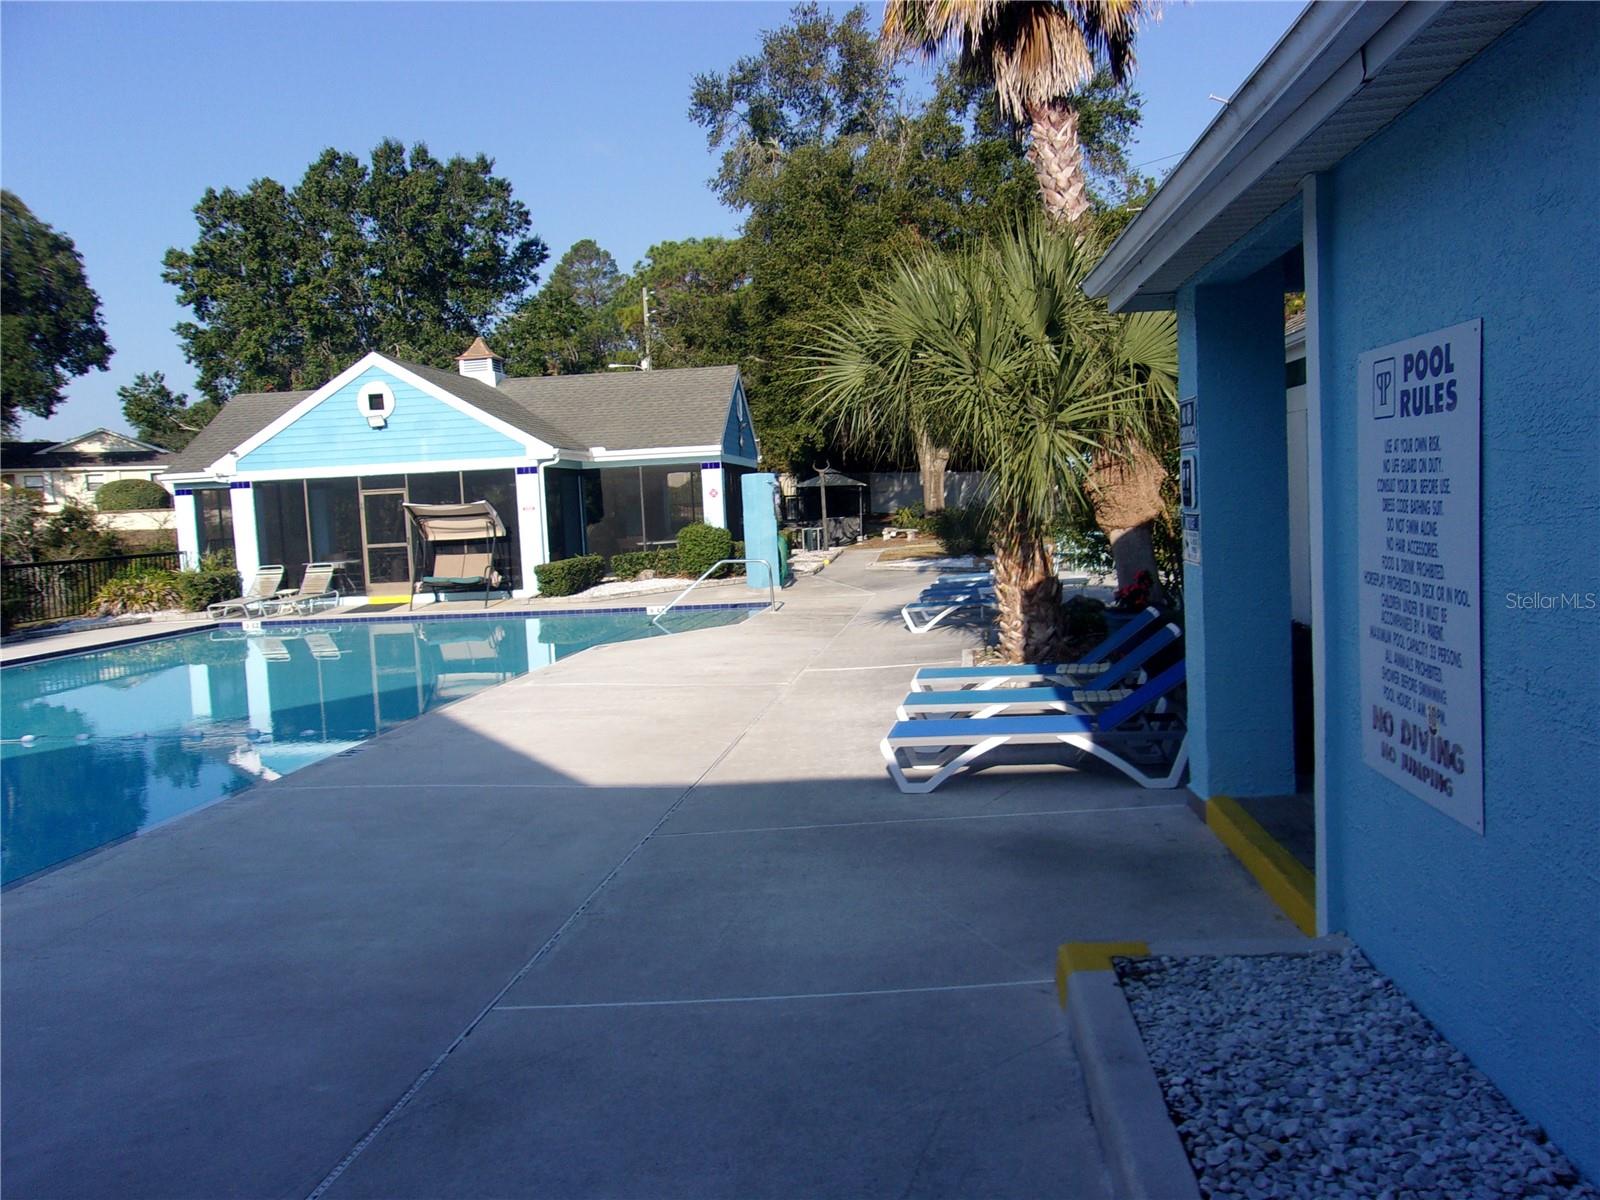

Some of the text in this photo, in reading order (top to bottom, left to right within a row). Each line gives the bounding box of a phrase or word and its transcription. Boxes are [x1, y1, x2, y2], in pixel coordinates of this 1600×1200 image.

[1403, 342, 1454, 383] POOL
[1400, 379, 1458, 418] RULES
[1400, 438, 1413, 453] YOUR
[1415, 437, 1427, 452] OWN
[1382, 459, 1390, 473] NO
[1418, 458, 1427, 473] ON
[1386, 517, 1394, 531] DO
[1395, 518, 1405, 533] NOT
[1386, 537, 1394, 551] NO
[1381, 555, 1394, 570] FOOD
[1413, 580, 1420, 596] ON
[1422, 582, 1435, 599] DECK
[1437, 585, 1444, 601] OR
[1446, 587, 1453, 603] IN
[1441, 607, 1447, 623] BE
[1393, 632, 1405, 650] POOL
[1372, 704, 1465, 775] NO DIVING
[1381, 741, 1453, 797] NO JUMPING
